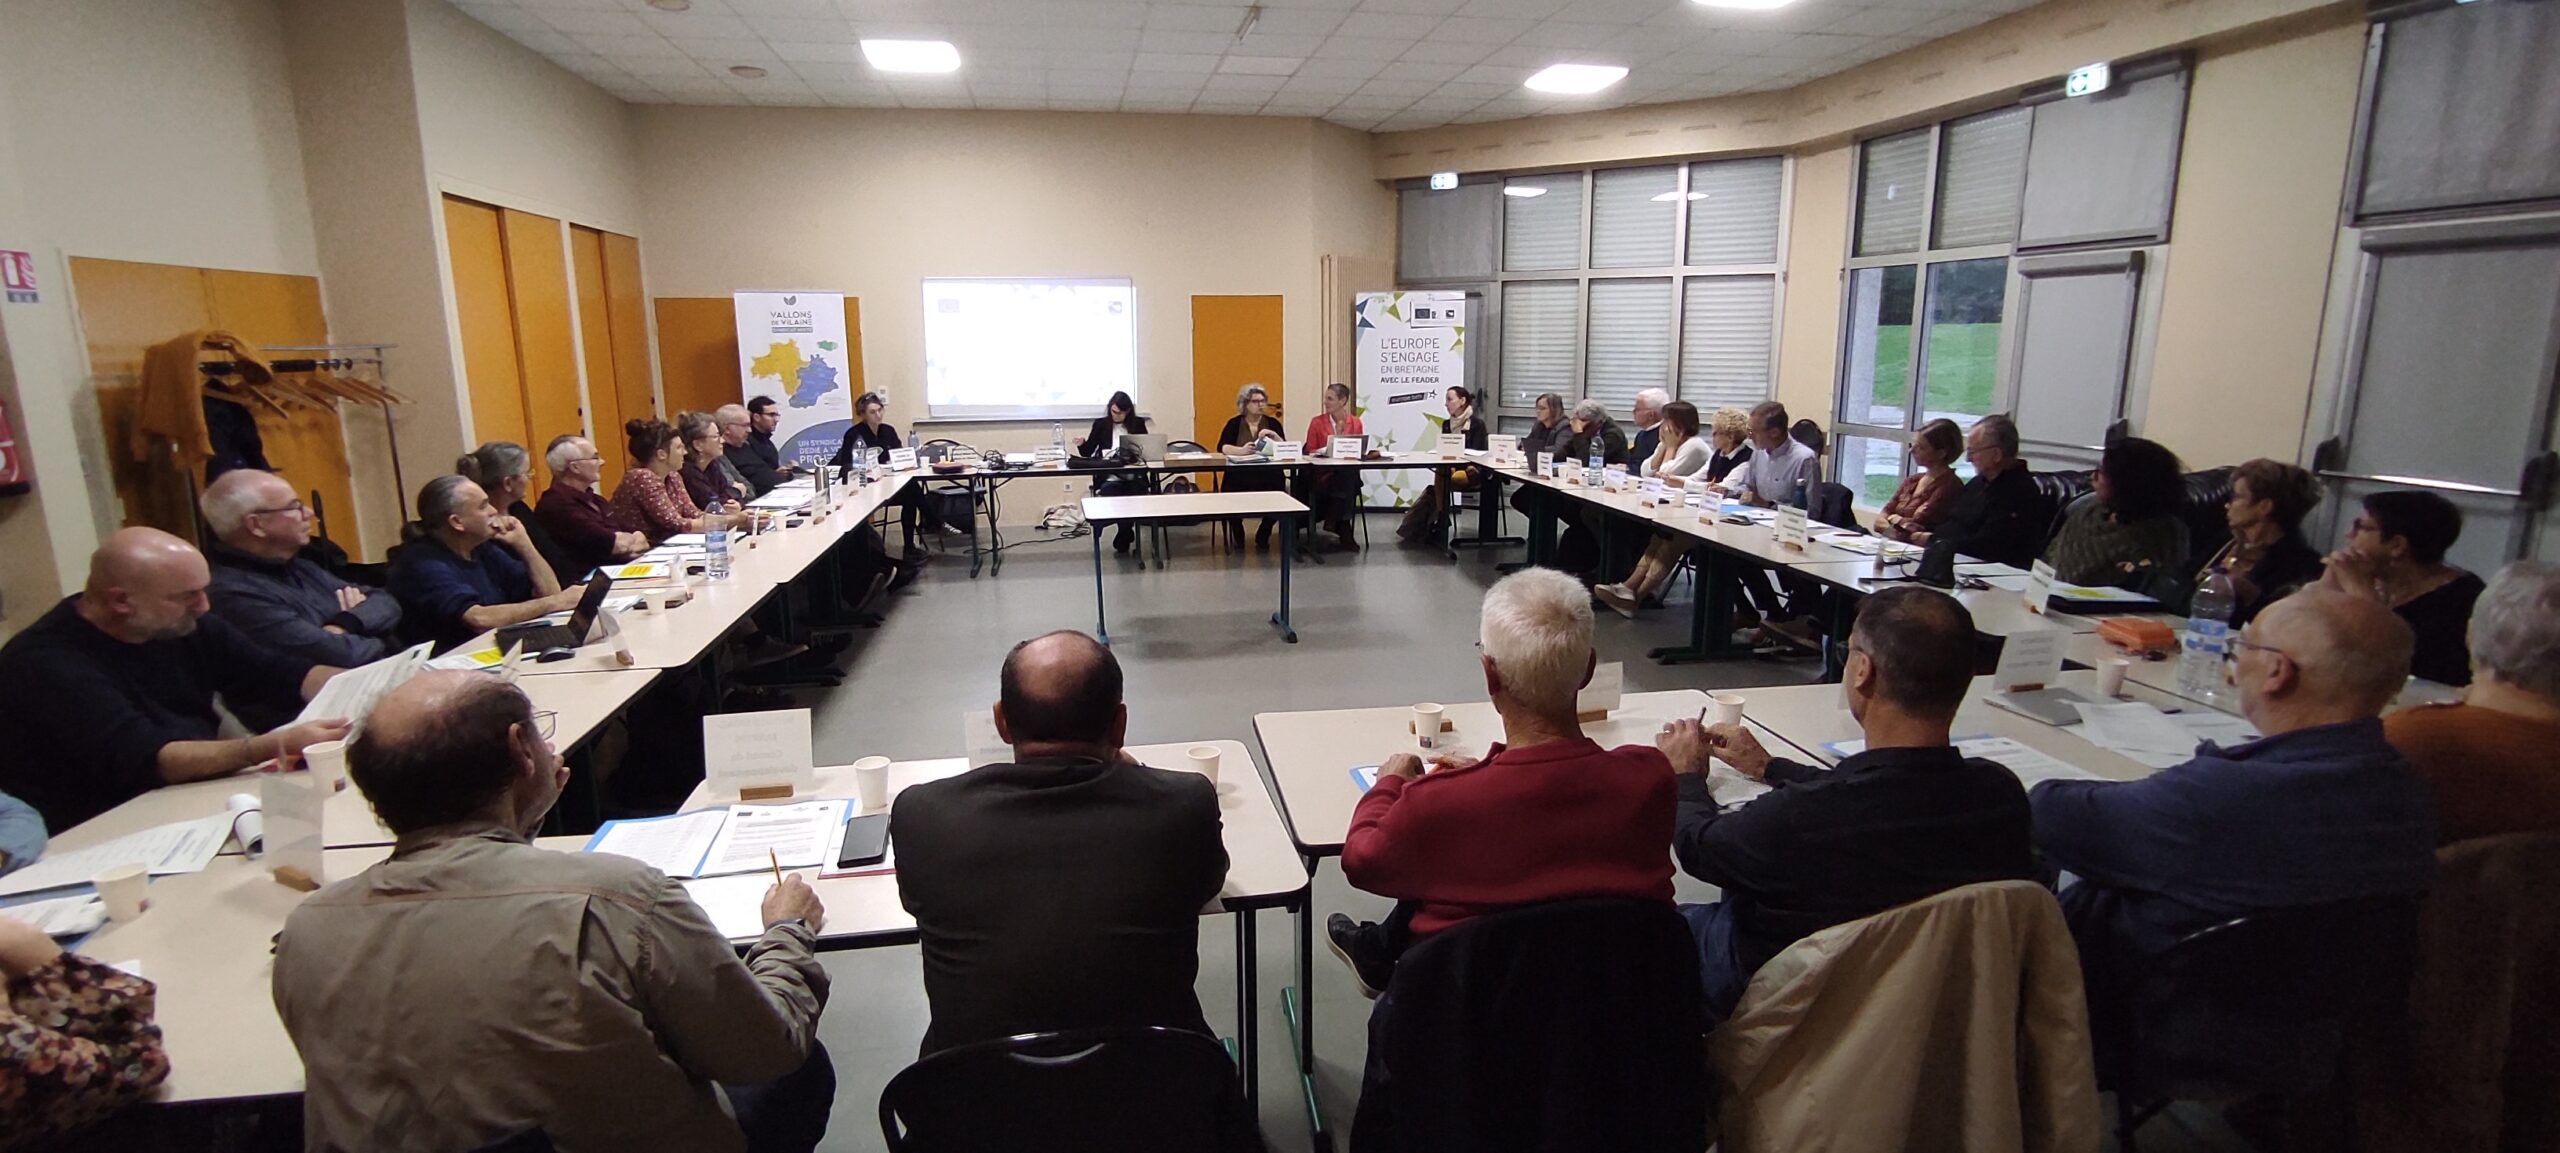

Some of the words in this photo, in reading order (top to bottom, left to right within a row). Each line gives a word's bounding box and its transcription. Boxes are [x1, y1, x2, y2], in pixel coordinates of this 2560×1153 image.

[770, 311, 812, 319] VALLONS
[1381, 338, 1440, 349] L'EUROPE
[1381, 352, 1440, 363] S'ENGAGE
[1381, 366, 1393, 374] EN
[1395, 365, 1440, 374] BRETAGNE
